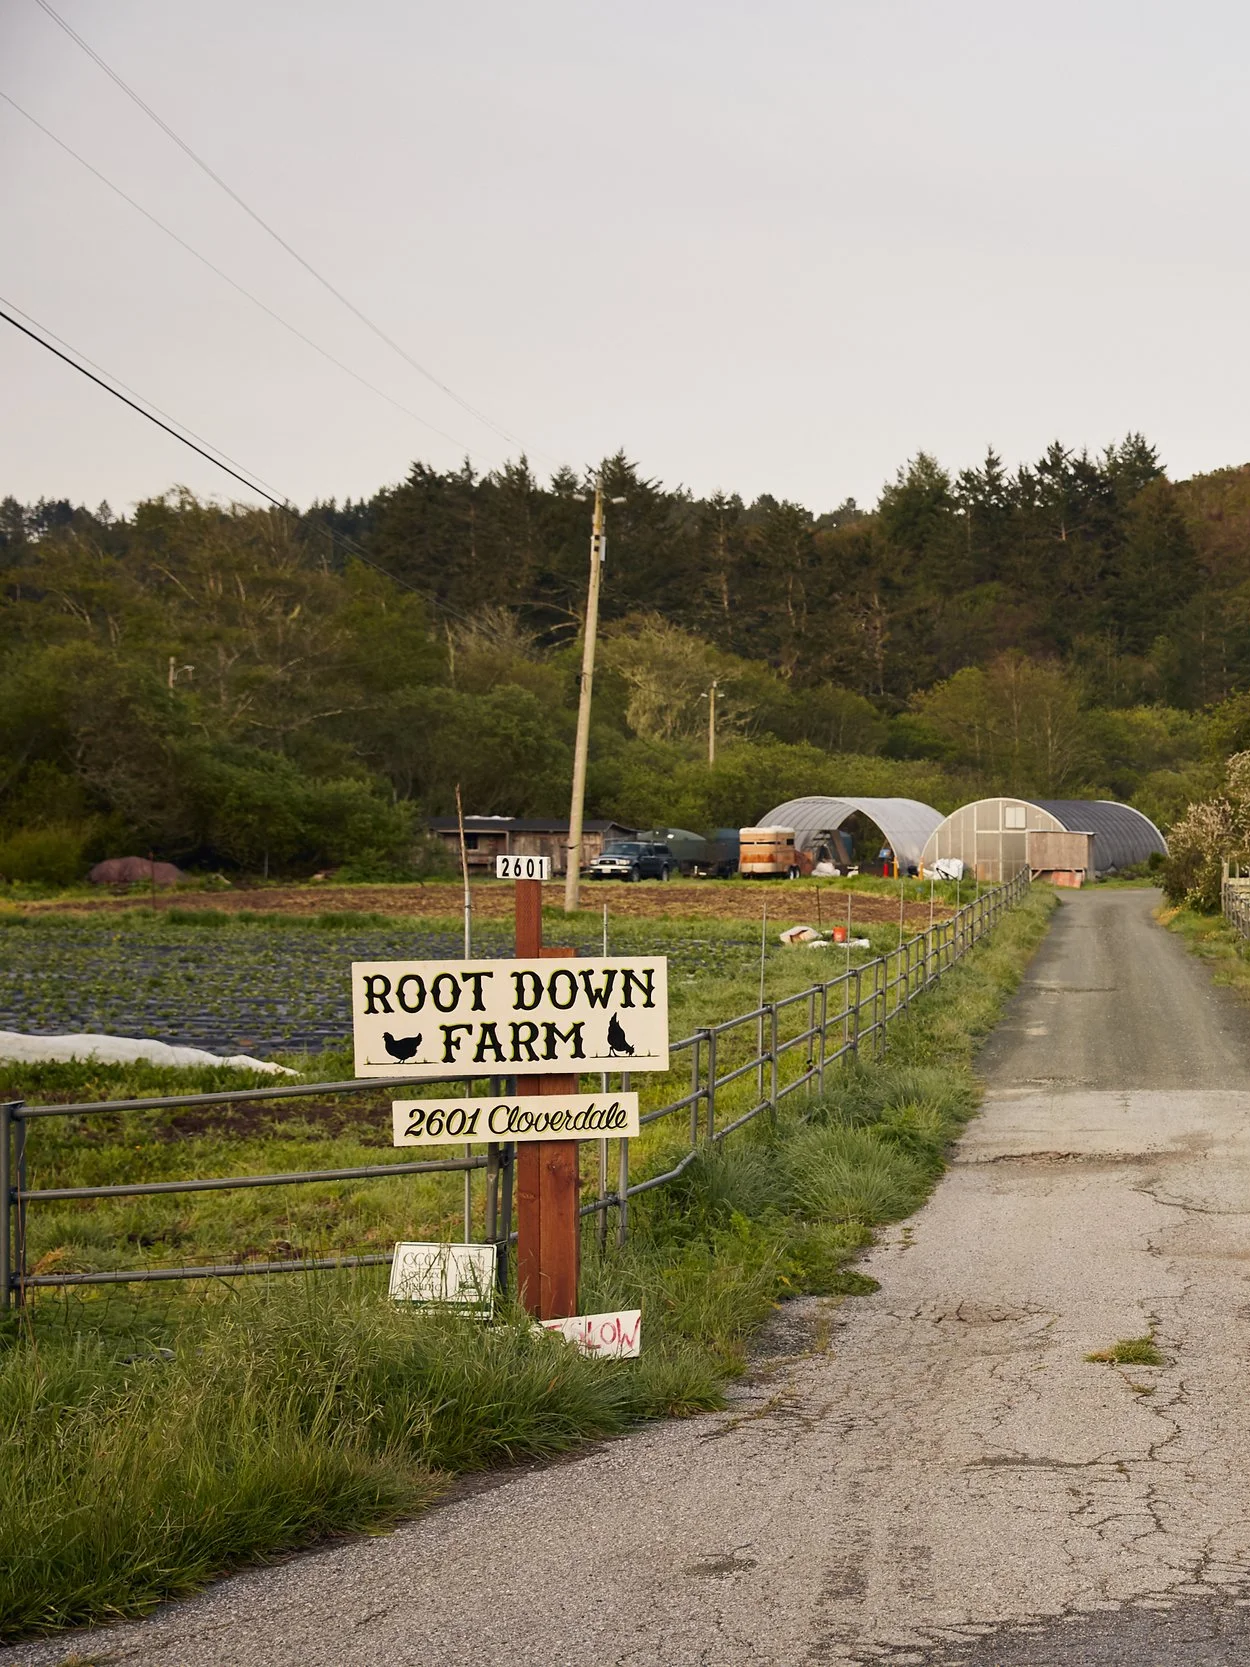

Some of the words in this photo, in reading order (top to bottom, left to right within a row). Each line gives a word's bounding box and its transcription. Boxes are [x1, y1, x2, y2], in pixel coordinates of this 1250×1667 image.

[501, 857, 543, 879] 2601
[363, 971, 494, 1015] ROOT
[510, 968, 656, 1011] DOWN
[439, 1021, 587, 1064] FARM
[404, 1107, 481, 1137] 2601
[488, 1101, 628, 1135] Cloverdale
